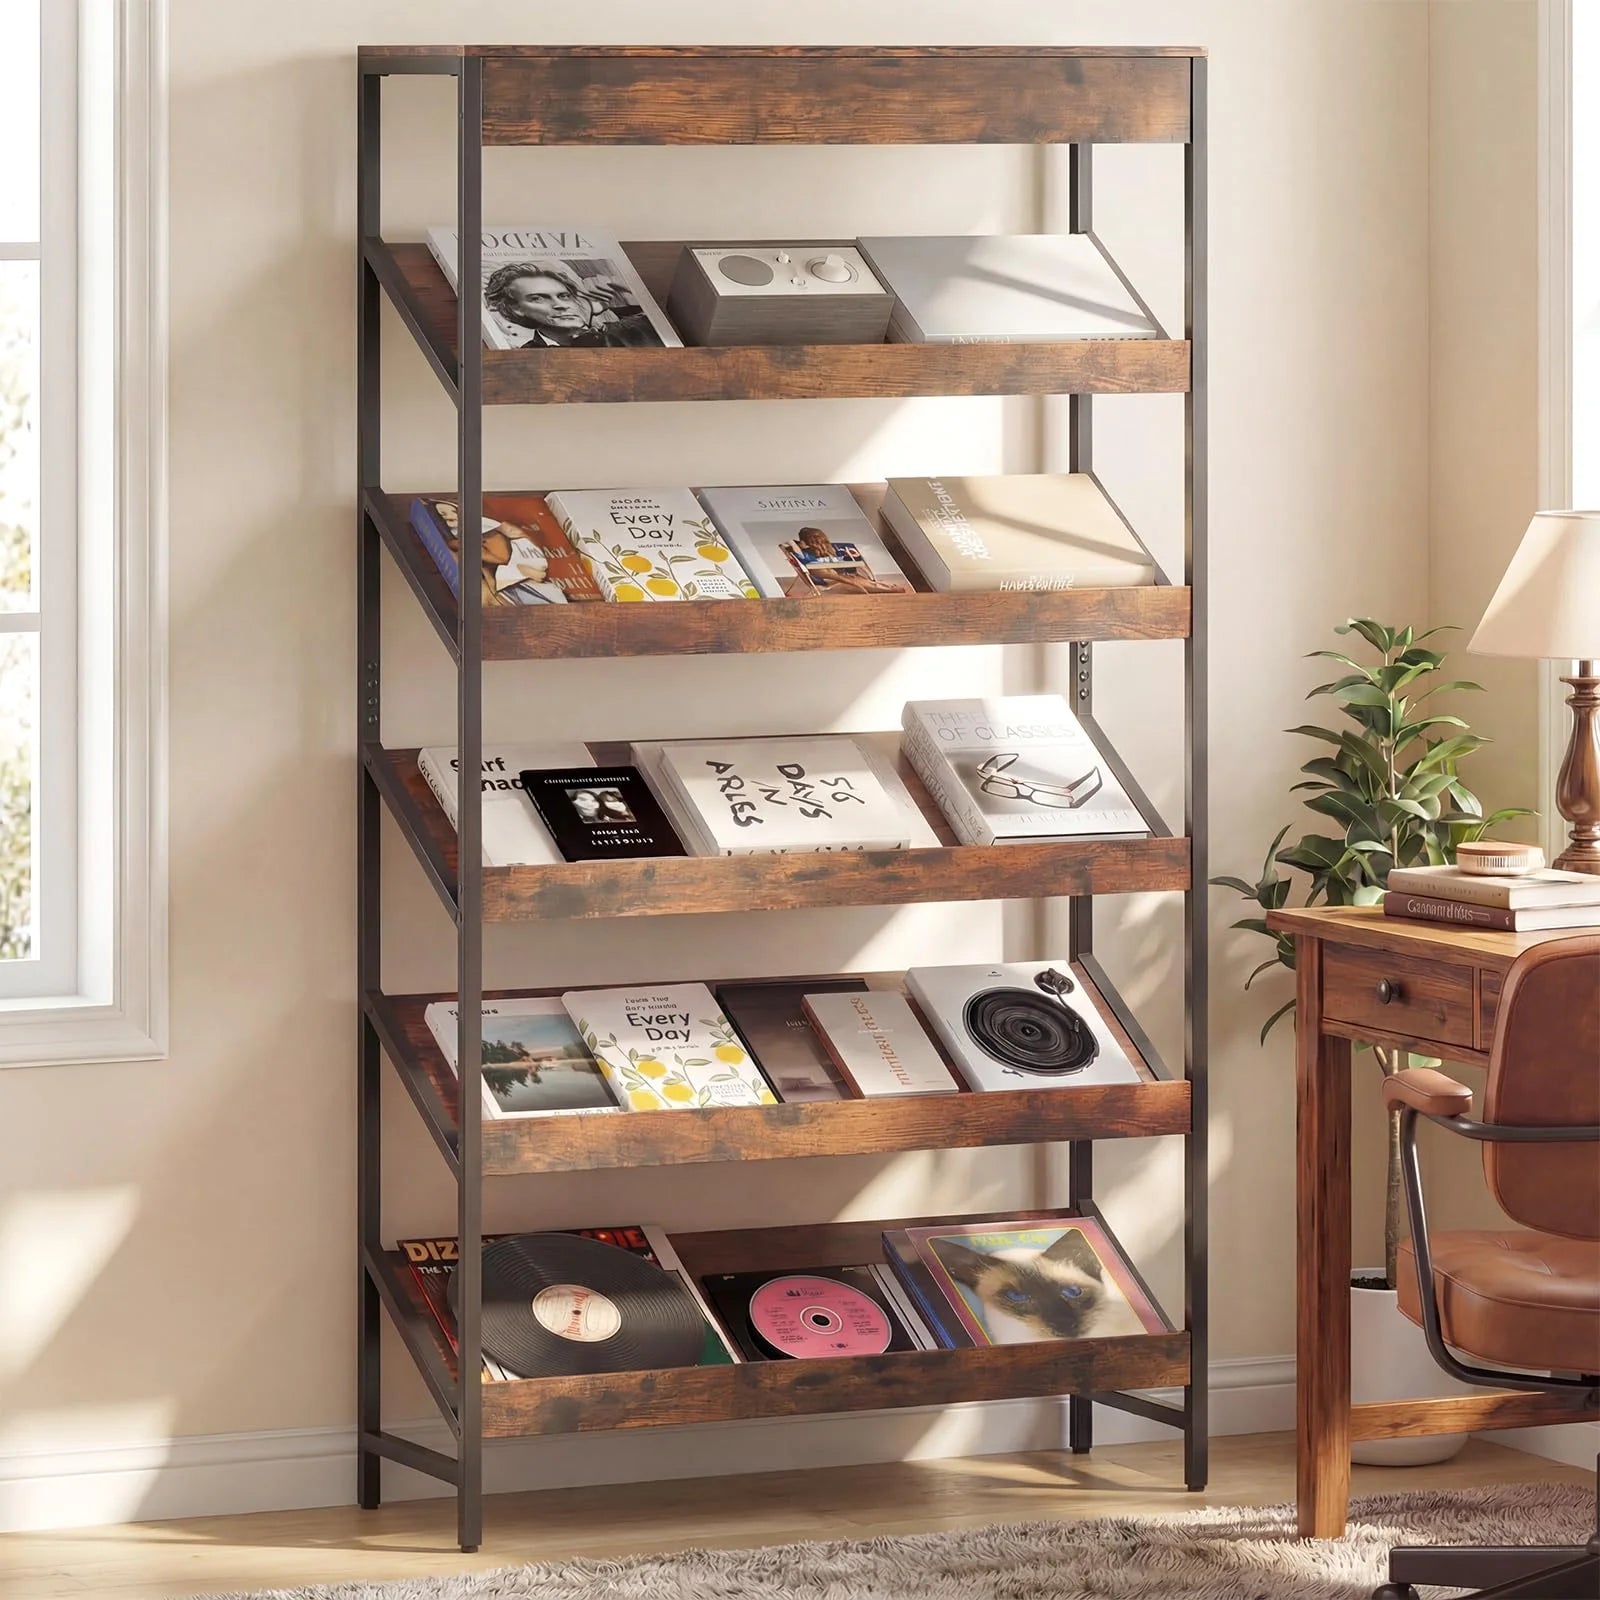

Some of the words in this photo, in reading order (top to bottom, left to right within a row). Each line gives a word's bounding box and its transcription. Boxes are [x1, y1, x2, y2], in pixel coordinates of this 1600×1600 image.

[610, 511, 673, 526] Every
[628, 526, 674, 541] Day
[937, 726, 968, 741] OF
[706, 760, 764, 827] ARLES
[627, 1014, 696, 1029] Every
[648, 1030, 697, 1047] Day
[403, 1241, 459, 1262] DIZ
